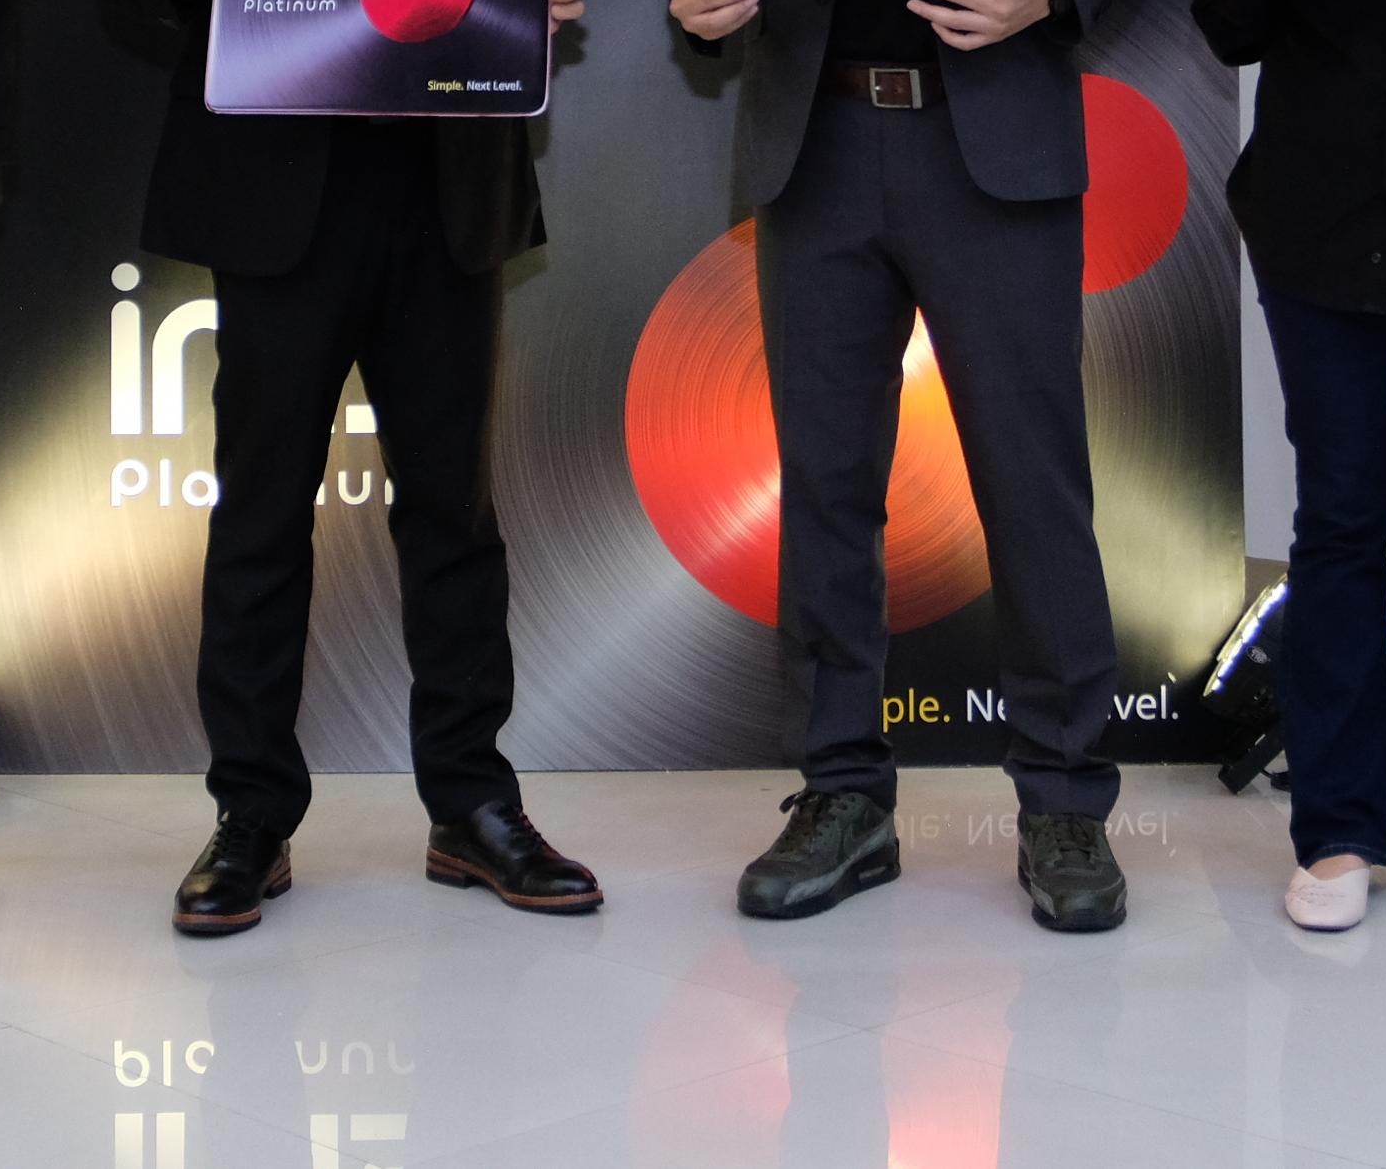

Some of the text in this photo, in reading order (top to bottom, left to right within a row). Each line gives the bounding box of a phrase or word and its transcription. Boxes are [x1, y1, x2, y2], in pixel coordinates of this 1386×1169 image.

[427, 80, 522, 93] Simple. Next Level.
